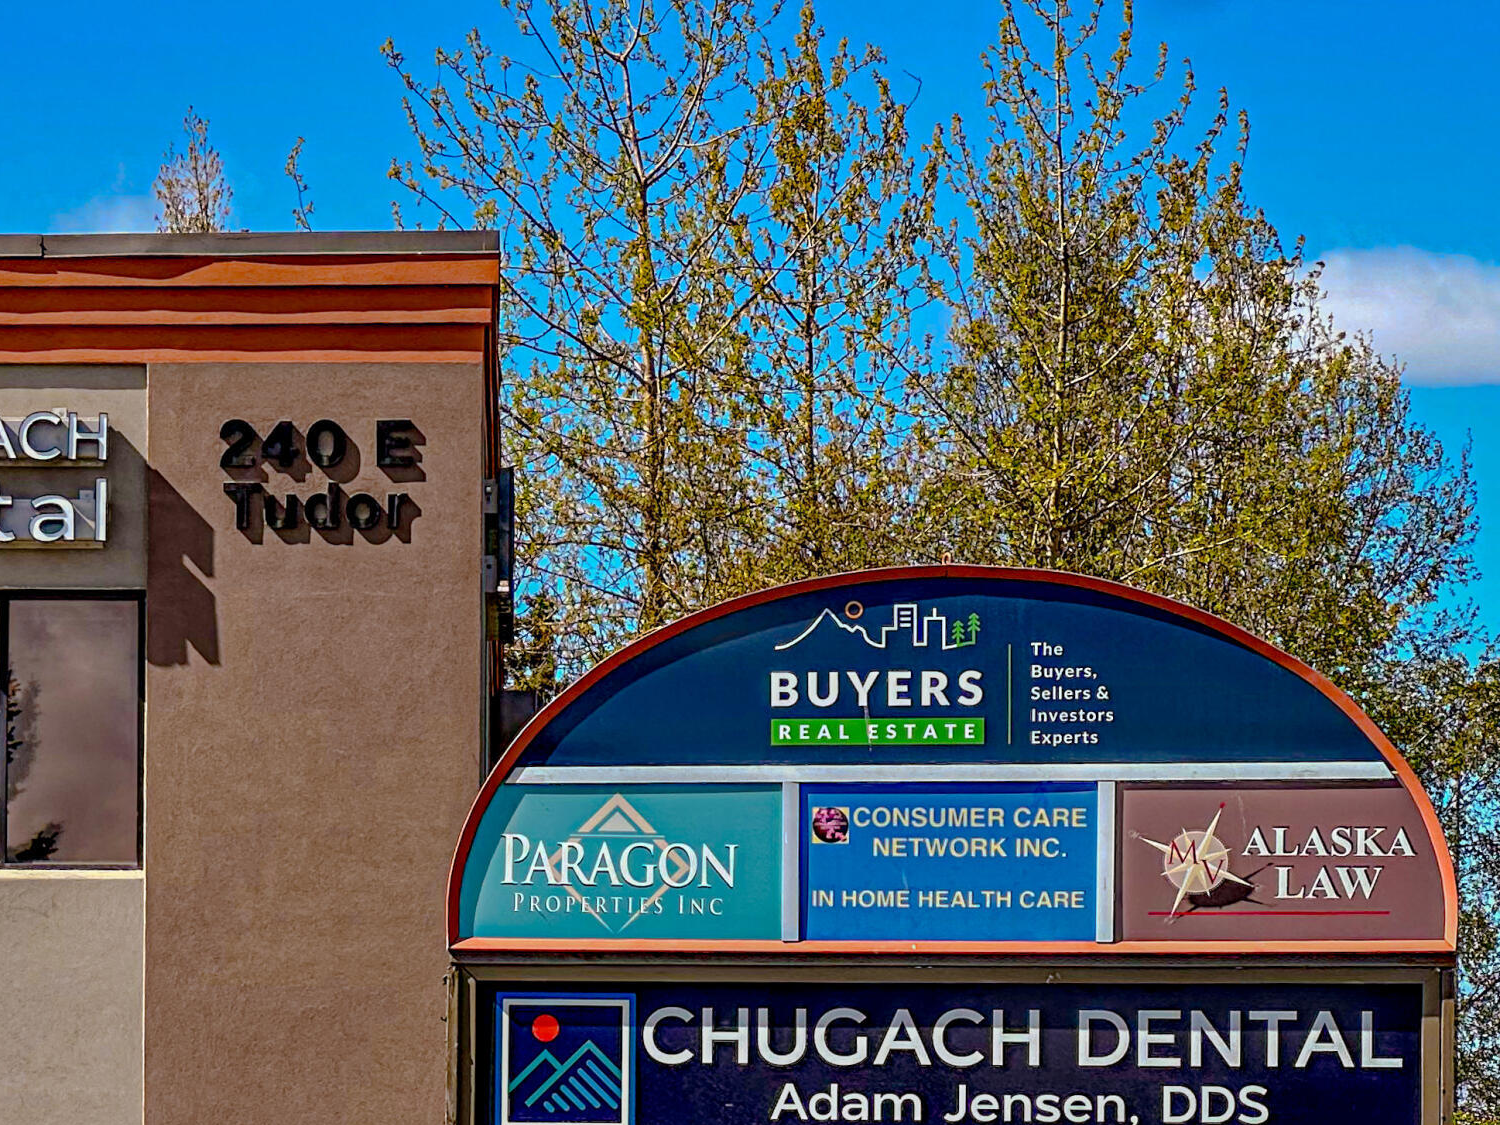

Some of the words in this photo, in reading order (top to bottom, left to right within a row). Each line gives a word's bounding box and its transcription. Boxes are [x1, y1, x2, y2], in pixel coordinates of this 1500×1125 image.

[220, 418, 347, 468] 240
[376, 419, 412, 467] E
[223, 481, 408, 530] Tudor
[1030, 641, 1064, 656] The
[1030, 664, 1098, 681] Buyers,
[770, 670, 984, 708] BUYERS
[1030, 685, 1091, 700] Sellers
[1096, 685, 1110, 700] &
[1030, 707, 1114, 722] Investors
[778, 723, 850, 740] REAL
[867, 723, 977, 740] ESTATE
[1030, 730, 1099, 748] Experts
[852, 806, 1005, 828] CONSUMER
[1013, 807, 1088, 828] CARE
[873, 837, 1005, 858] NETWORK
[1015, 837, 1067, 858] INC.
[1241, 825, 1418, 858] ALASKA
[500, 832, 740, 889] PARAGON
[1275, 866, 1383, 900] LAW
[513, 893, 665, 914] PROPERTIES
[812, 890, 837, 908] IN
[842, 890, 913, 908] HOME
[918, 890, 1010, 908] HEALTH
[1014, 890, 1085, 908] CARE
[641, 1006, 1041, 1067] CHUGACH
[1077, 1008, 1404, 1069] DENTAL
[770, 1083, 923, 1123] Adam
